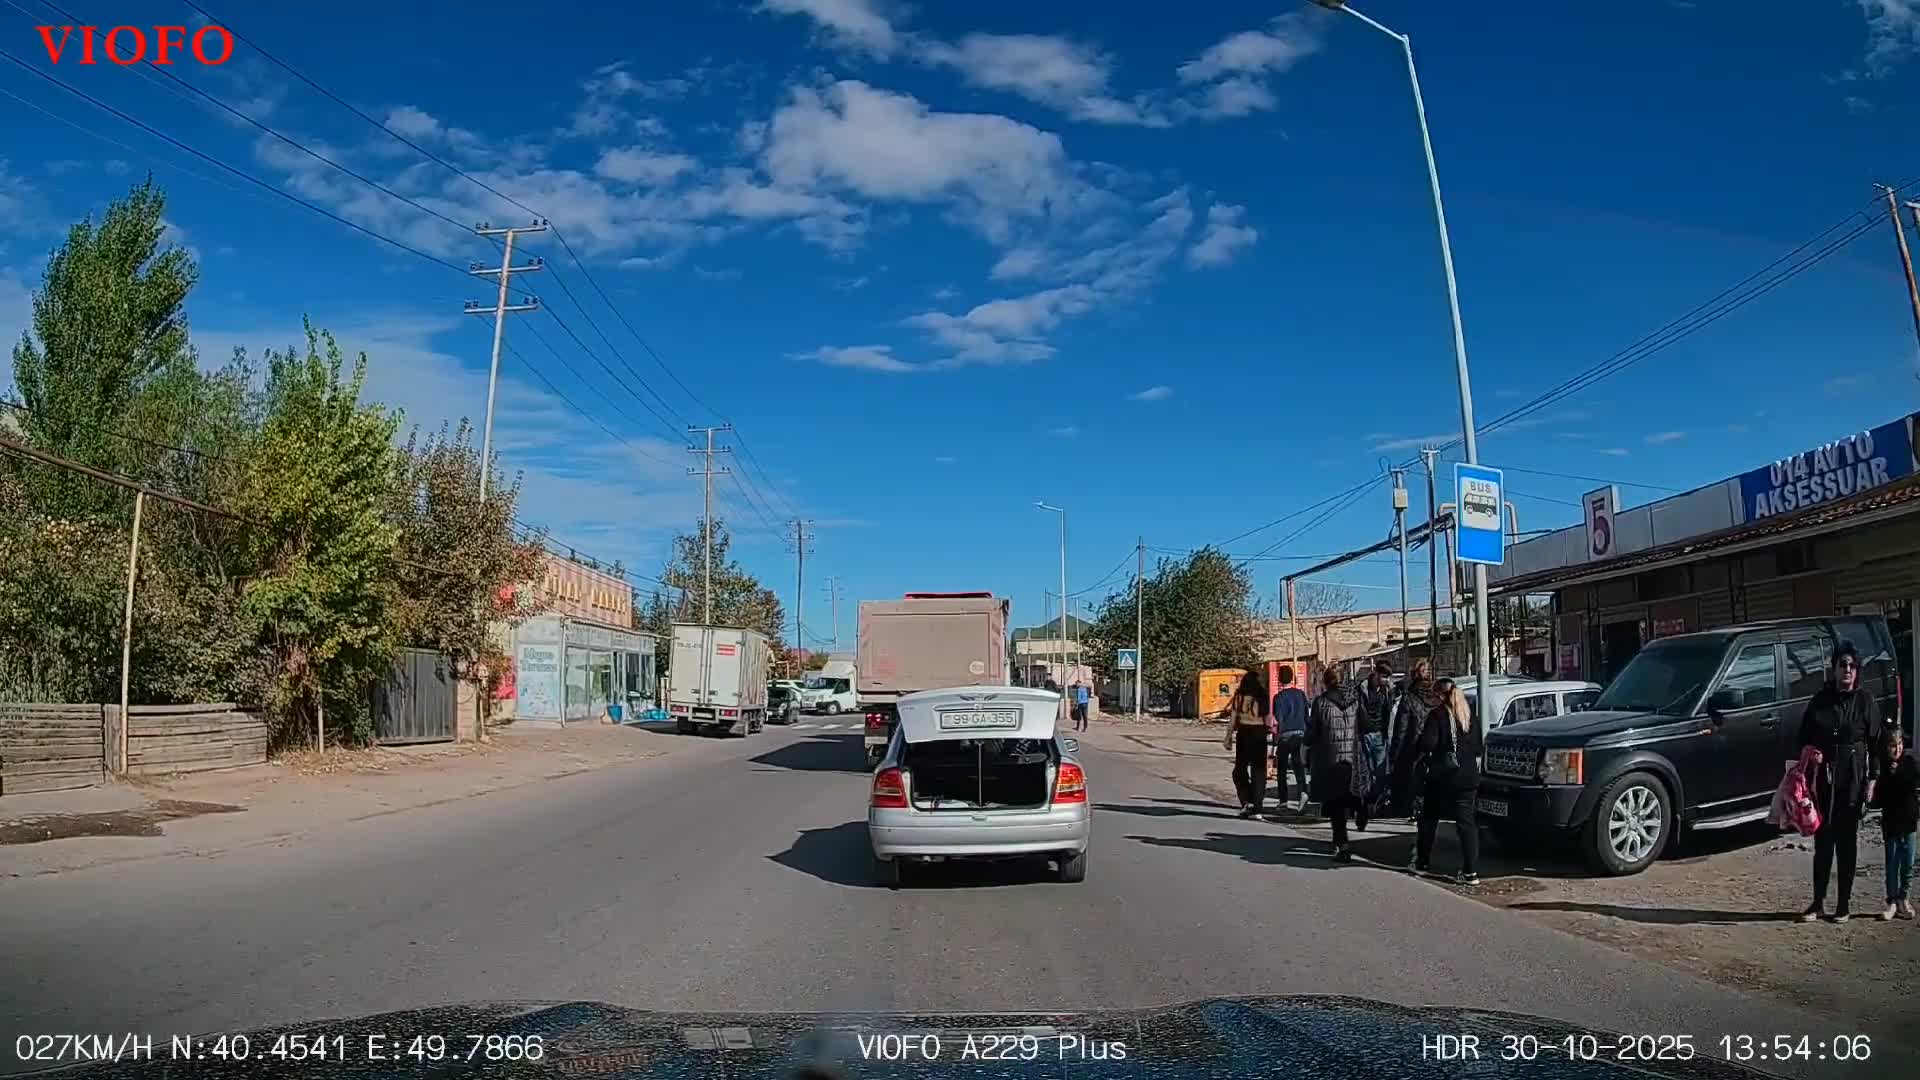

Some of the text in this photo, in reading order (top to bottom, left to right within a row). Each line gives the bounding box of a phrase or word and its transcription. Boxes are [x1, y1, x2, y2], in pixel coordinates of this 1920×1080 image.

[1814, 430, 1875, 475] AVTO
[1470, 480, 1492, 494] BUS
[1755, 456, 1891, 520] AKSESSUAR
[1591, 496, 1611, 556] 5
